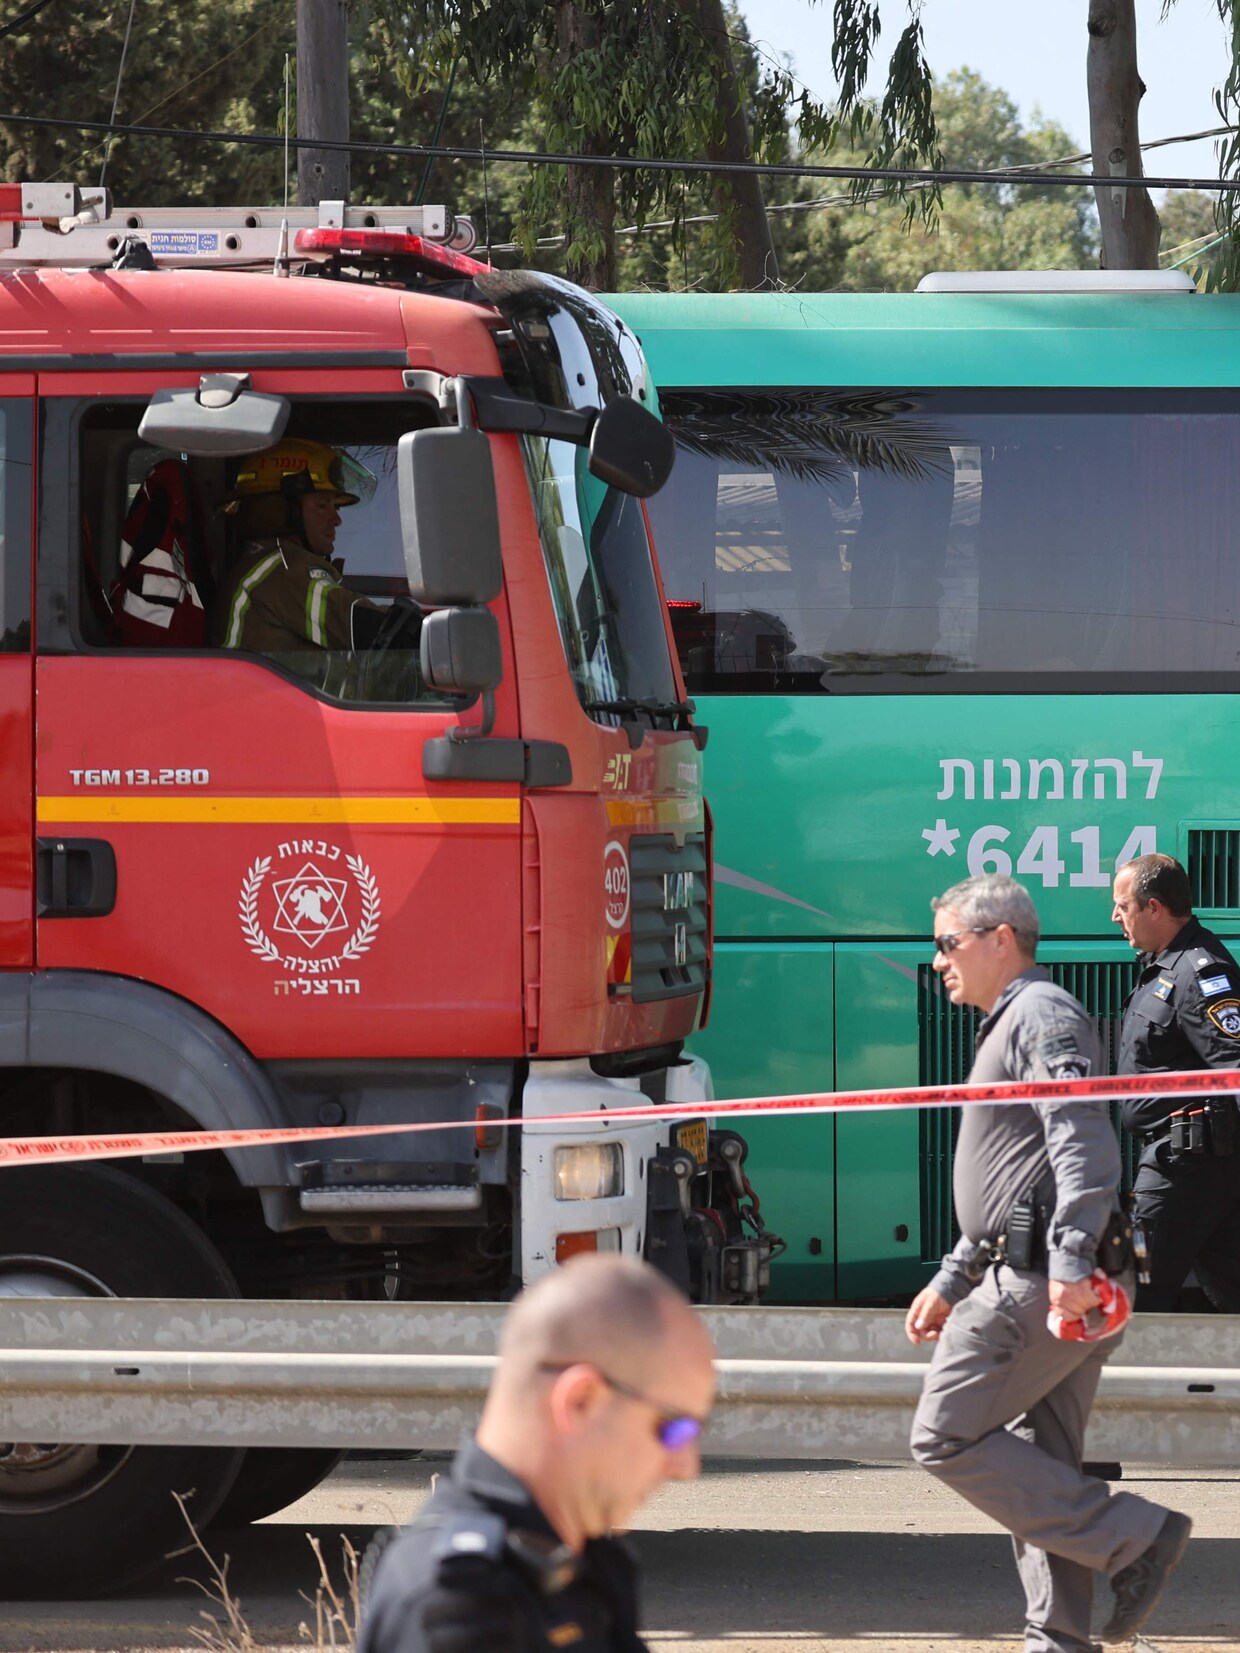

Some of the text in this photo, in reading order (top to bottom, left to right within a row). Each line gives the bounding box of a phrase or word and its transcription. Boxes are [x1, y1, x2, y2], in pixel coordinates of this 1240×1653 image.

[69, 768, 209, 785] TGM 13.280
[936, 750, 1164, 801] להזמנות
[277, 839, 342, 861] כבאות
[604, 866, 627, 894] 402
[283, 955, 341, 974] והצלה
[273, 977, 361, 996] הרצליה
